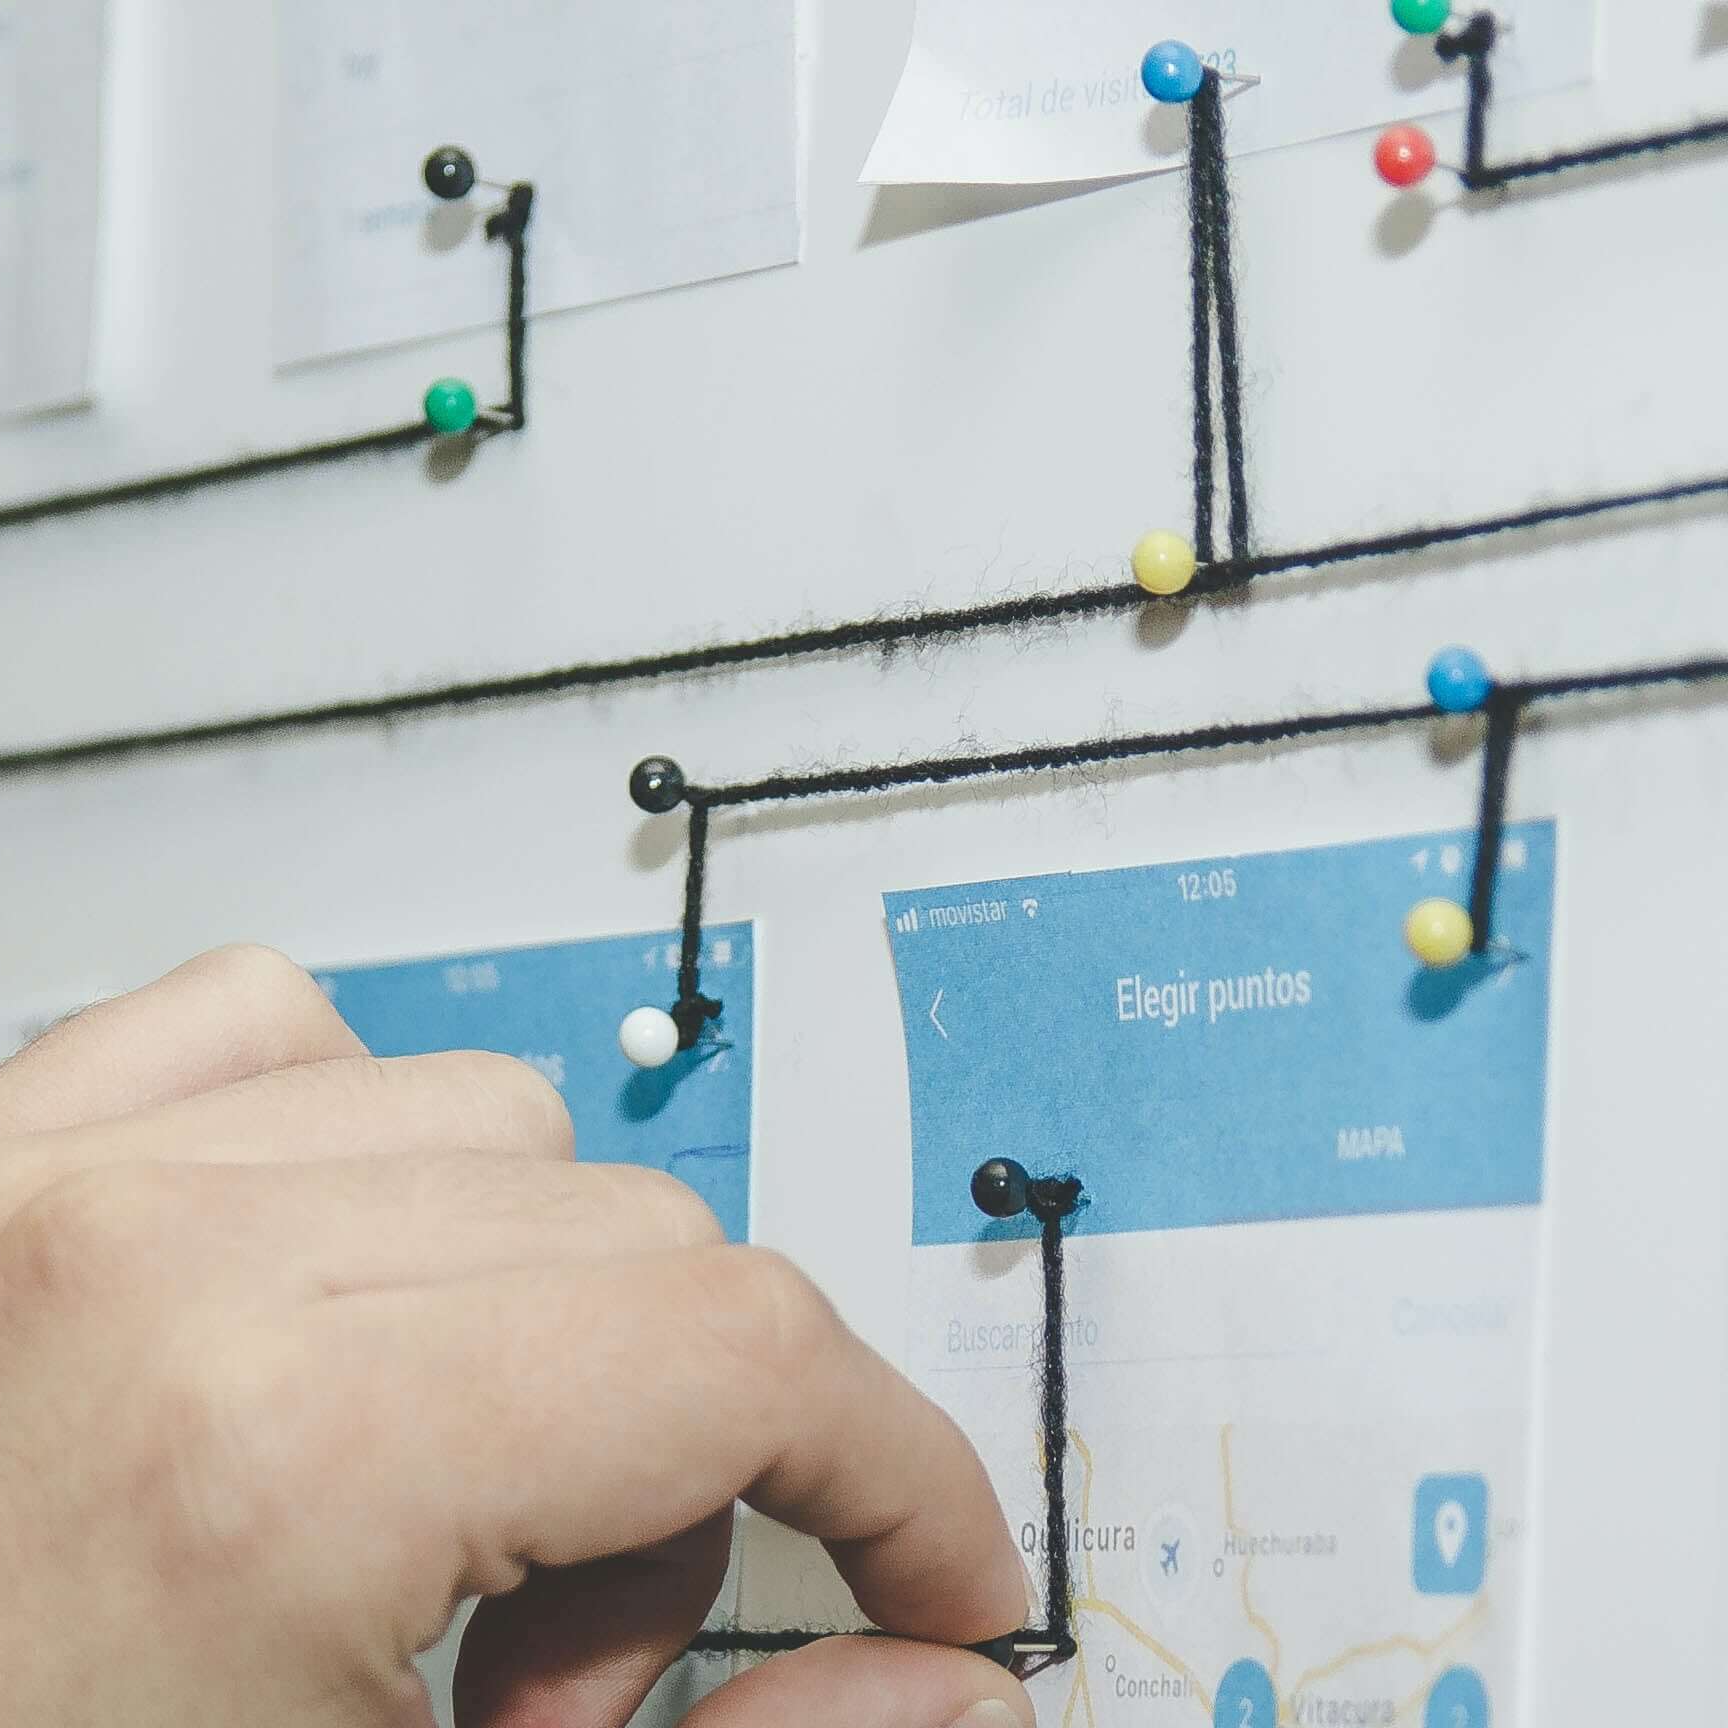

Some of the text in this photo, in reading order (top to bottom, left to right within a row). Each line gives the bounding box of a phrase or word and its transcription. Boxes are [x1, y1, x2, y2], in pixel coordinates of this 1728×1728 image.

[960, 80, 1033, 121] Total
[1041, 76, 1075, 114] de
[1178, 869, 1237, 901] 12:05
[929, 897, 1008, 928] movistar
[1117, 966, 1311, 1027] Elegir puntos
[1337, 1126, 1405, 1159] MAPA
[947, 1320, 1024, 1353] Buscar
[1021, 1517, 1135, 1555] Qulicura
